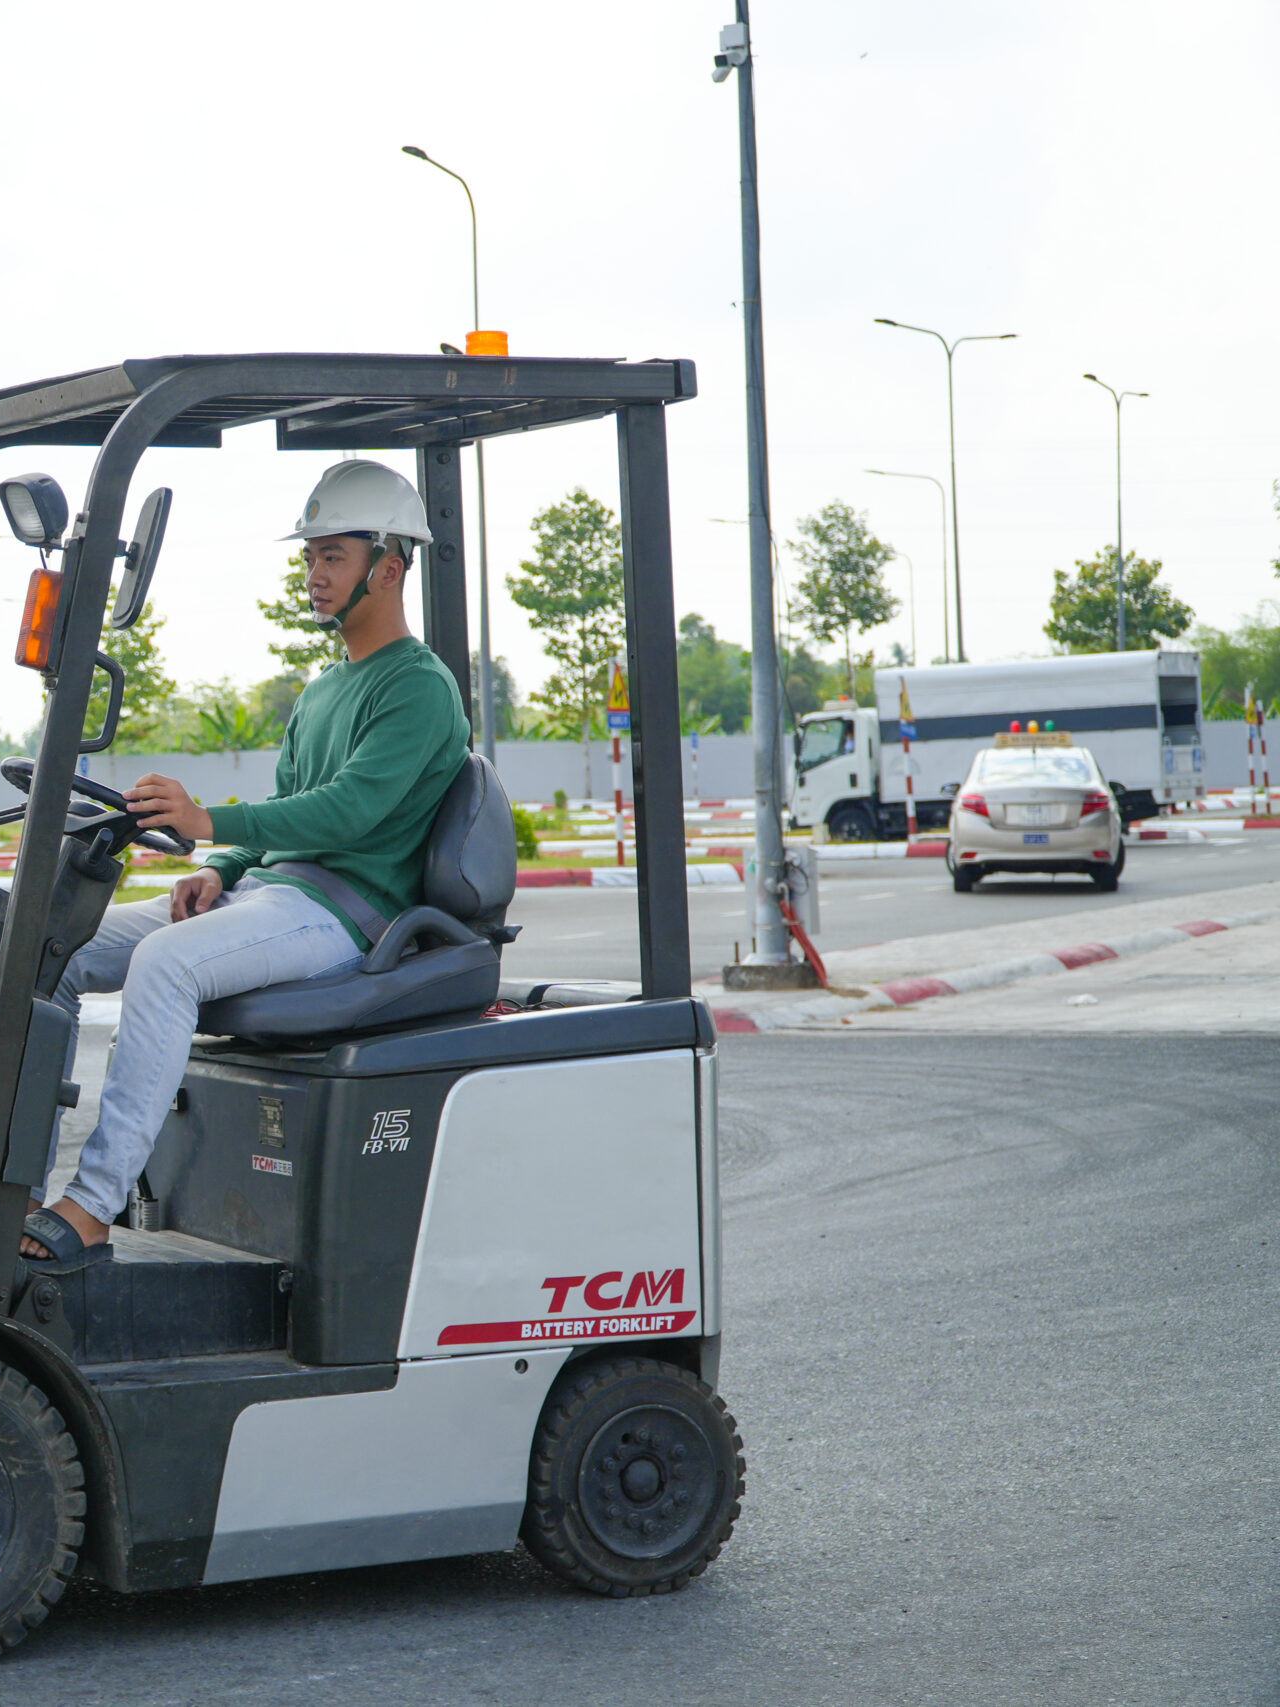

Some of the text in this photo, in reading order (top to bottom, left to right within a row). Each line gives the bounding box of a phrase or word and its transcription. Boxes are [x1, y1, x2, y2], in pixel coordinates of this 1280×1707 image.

[370, 1108, 412, 1140] 15
[253, 1156, 274, 1172] TCM
[541, 1268, 685, 1314] TCM
[521, 1315, 676, 1339] BATTERY FORKLIFT
